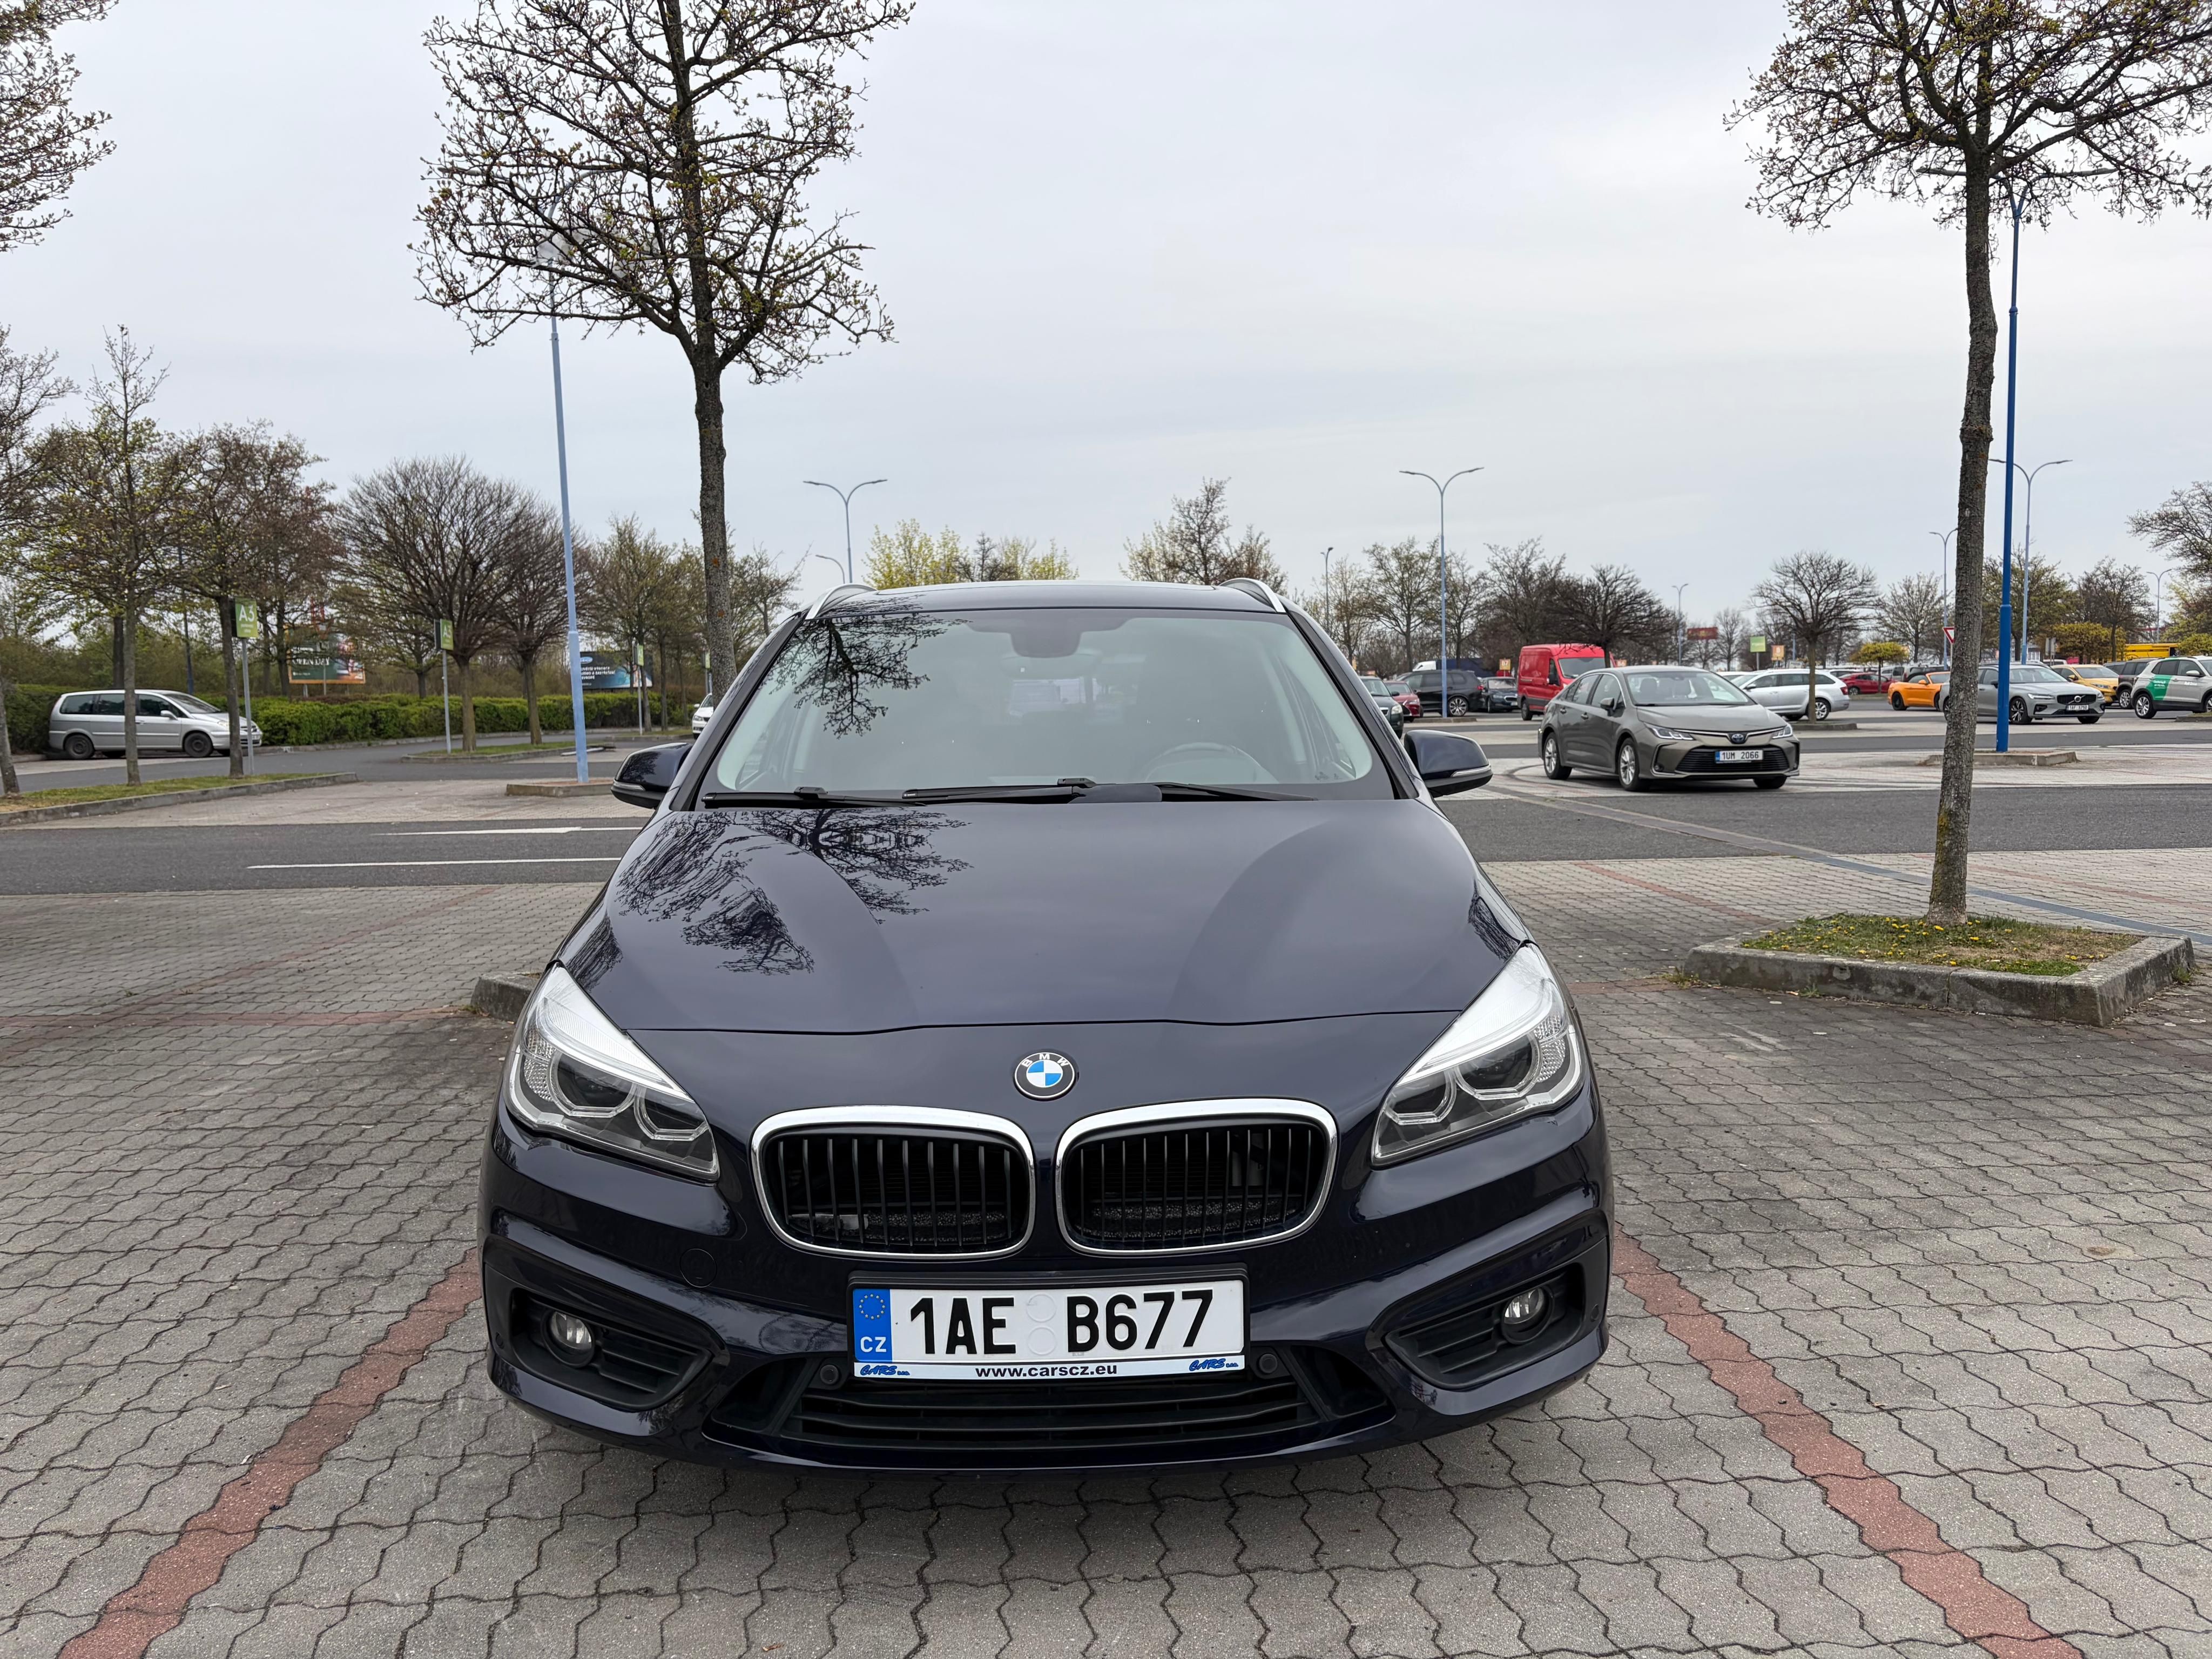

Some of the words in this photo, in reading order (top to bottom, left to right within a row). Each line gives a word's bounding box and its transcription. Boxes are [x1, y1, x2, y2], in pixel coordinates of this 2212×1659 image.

[239, 604, 255, 622] A3
[1722, 752, 1735, 760] 1UM
[1741, 751, 1759, 759] 2066
[1021, 1054, 1070, 1068] BMW
[910, 1297, 1016, 1354] 1AE
[1067, 1289, 1213, 1353] B677
[860, 1336, 887, 1353] CZ
[860, 1364, 898, 1375] CARS
[975, 1365, 1117, 1377] www.carscz.eu
[1189, 1358, 1226, 1371] CARS
